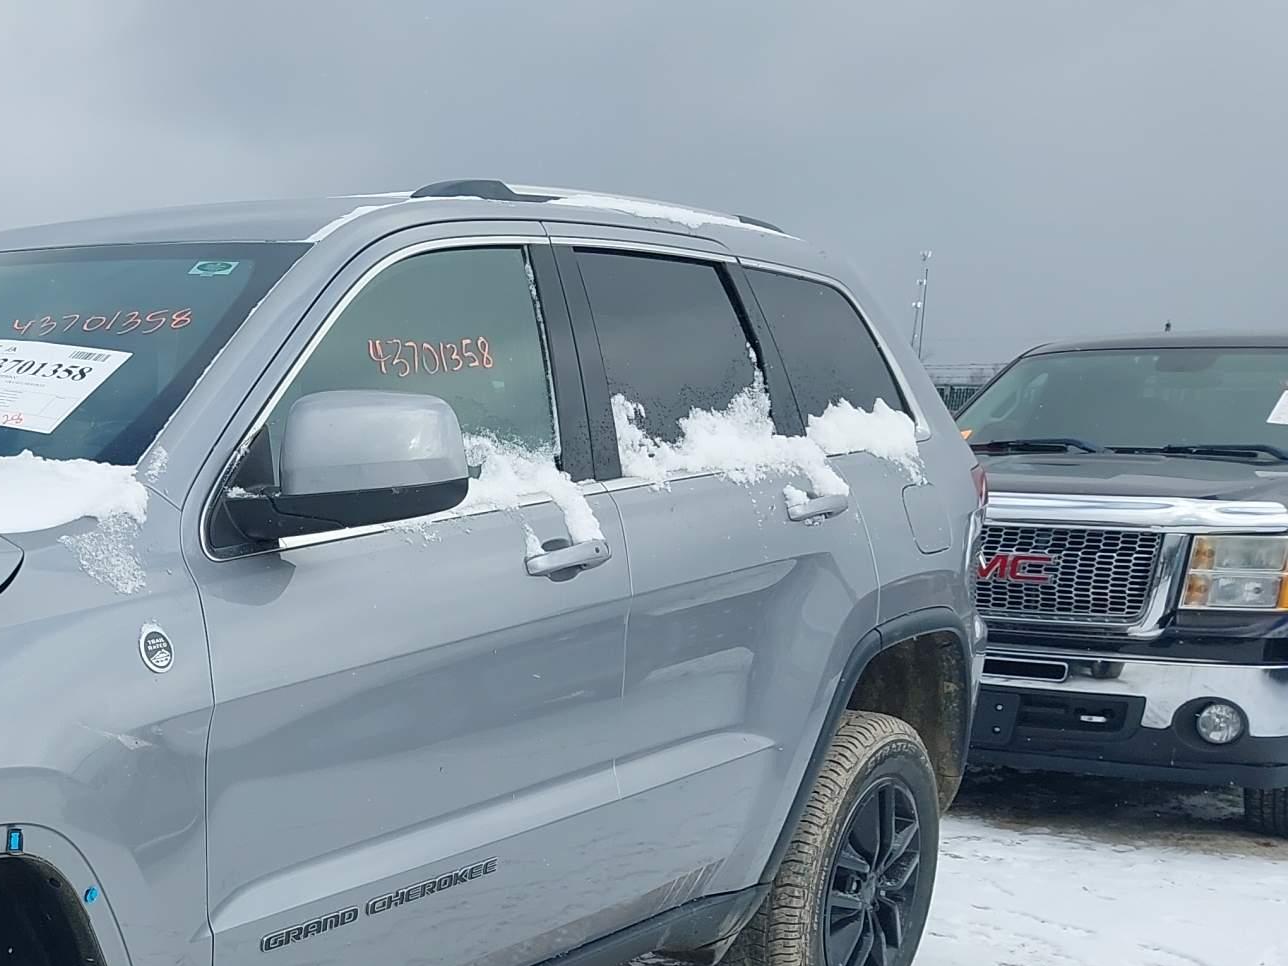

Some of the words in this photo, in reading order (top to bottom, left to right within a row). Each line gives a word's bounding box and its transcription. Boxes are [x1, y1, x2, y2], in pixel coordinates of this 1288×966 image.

[13, 307, 192, 336] 43701358
[368, 336, 494, 377] 43701358
[260, 905, 359, 952] GRAND
[365, 856, 498, 916] CHEROKEE
